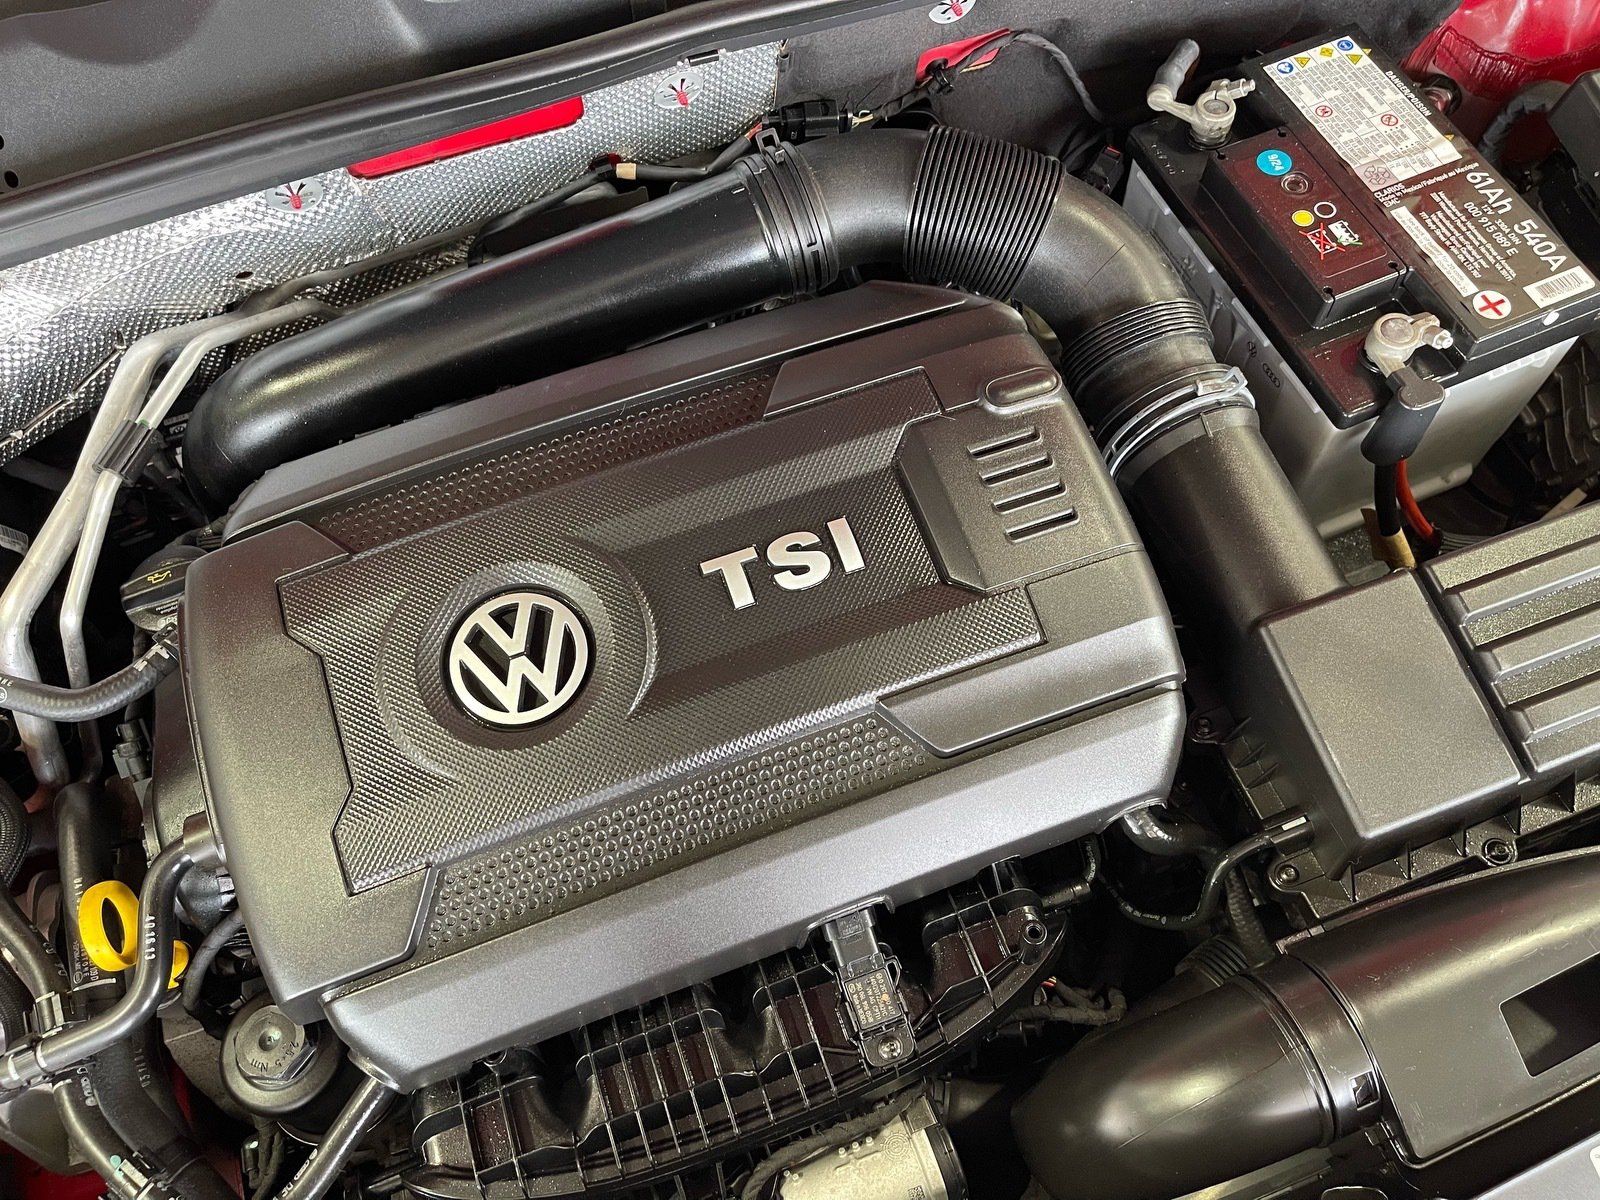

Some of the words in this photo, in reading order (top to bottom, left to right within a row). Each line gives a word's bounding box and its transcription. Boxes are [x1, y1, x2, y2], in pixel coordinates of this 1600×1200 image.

[1385, 71, 1432, 116] DANGER/POISON
[1374, 183, 1405, 198] CLARIOS
[1464, 202, 1482, 217] 000
[1478, 217, 1497, 232] 915
[1492, 232, 1511, 247] 089
[1506, 248, 1518, 256] E
[1466, 172, 1512, 214] 61Ah
[1514, 219, 1567, 272] 540A
[1508, 233, 1522, 245] DIN
[701, 516, 865, 610] TSI
